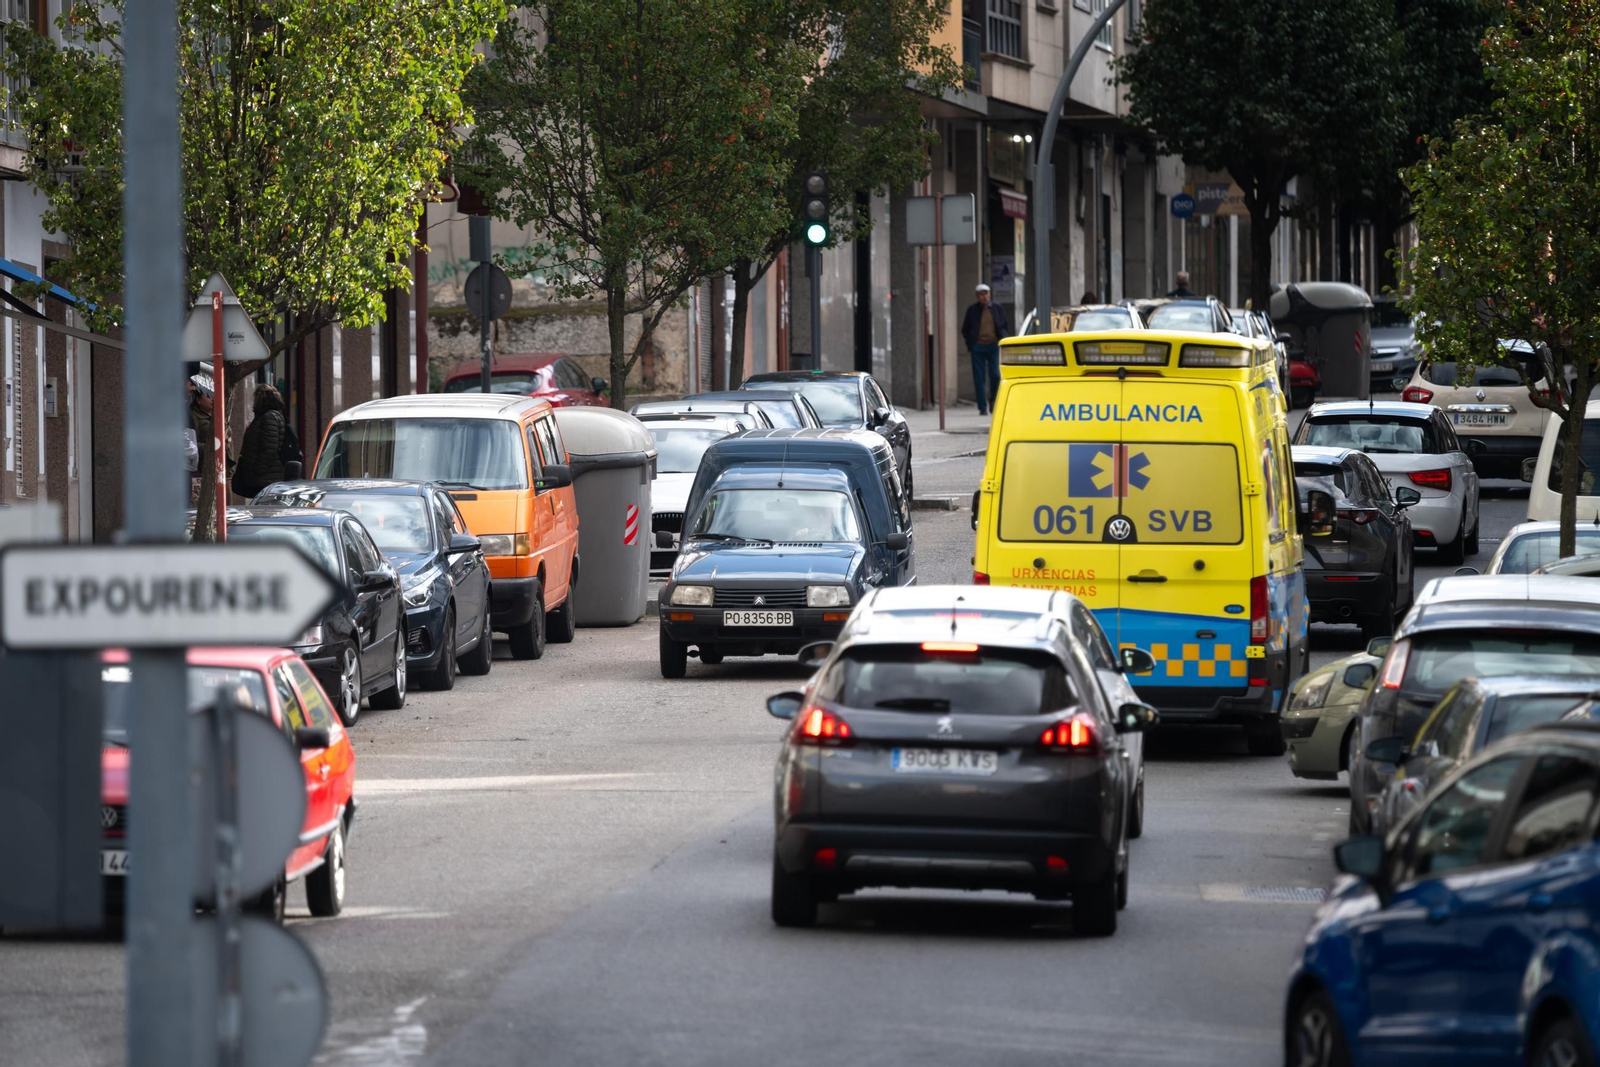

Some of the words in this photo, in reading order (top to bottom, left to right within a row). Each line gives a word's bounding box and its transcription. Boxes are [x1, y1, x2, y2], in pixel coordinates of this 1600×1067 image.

[1174, 200, 1193, 210] DIGI
[1039, 403, 1203, 423] AMBULANCIA
[1460, 414, 1484, 424] 3484
[1033, 505, 1094, 535] 061
[1148, 510, 1212, 532] SVB
[1012, 567, 1096, 581] URXENCIAS
[24, 576, 290, 617] EXPOURENSE
